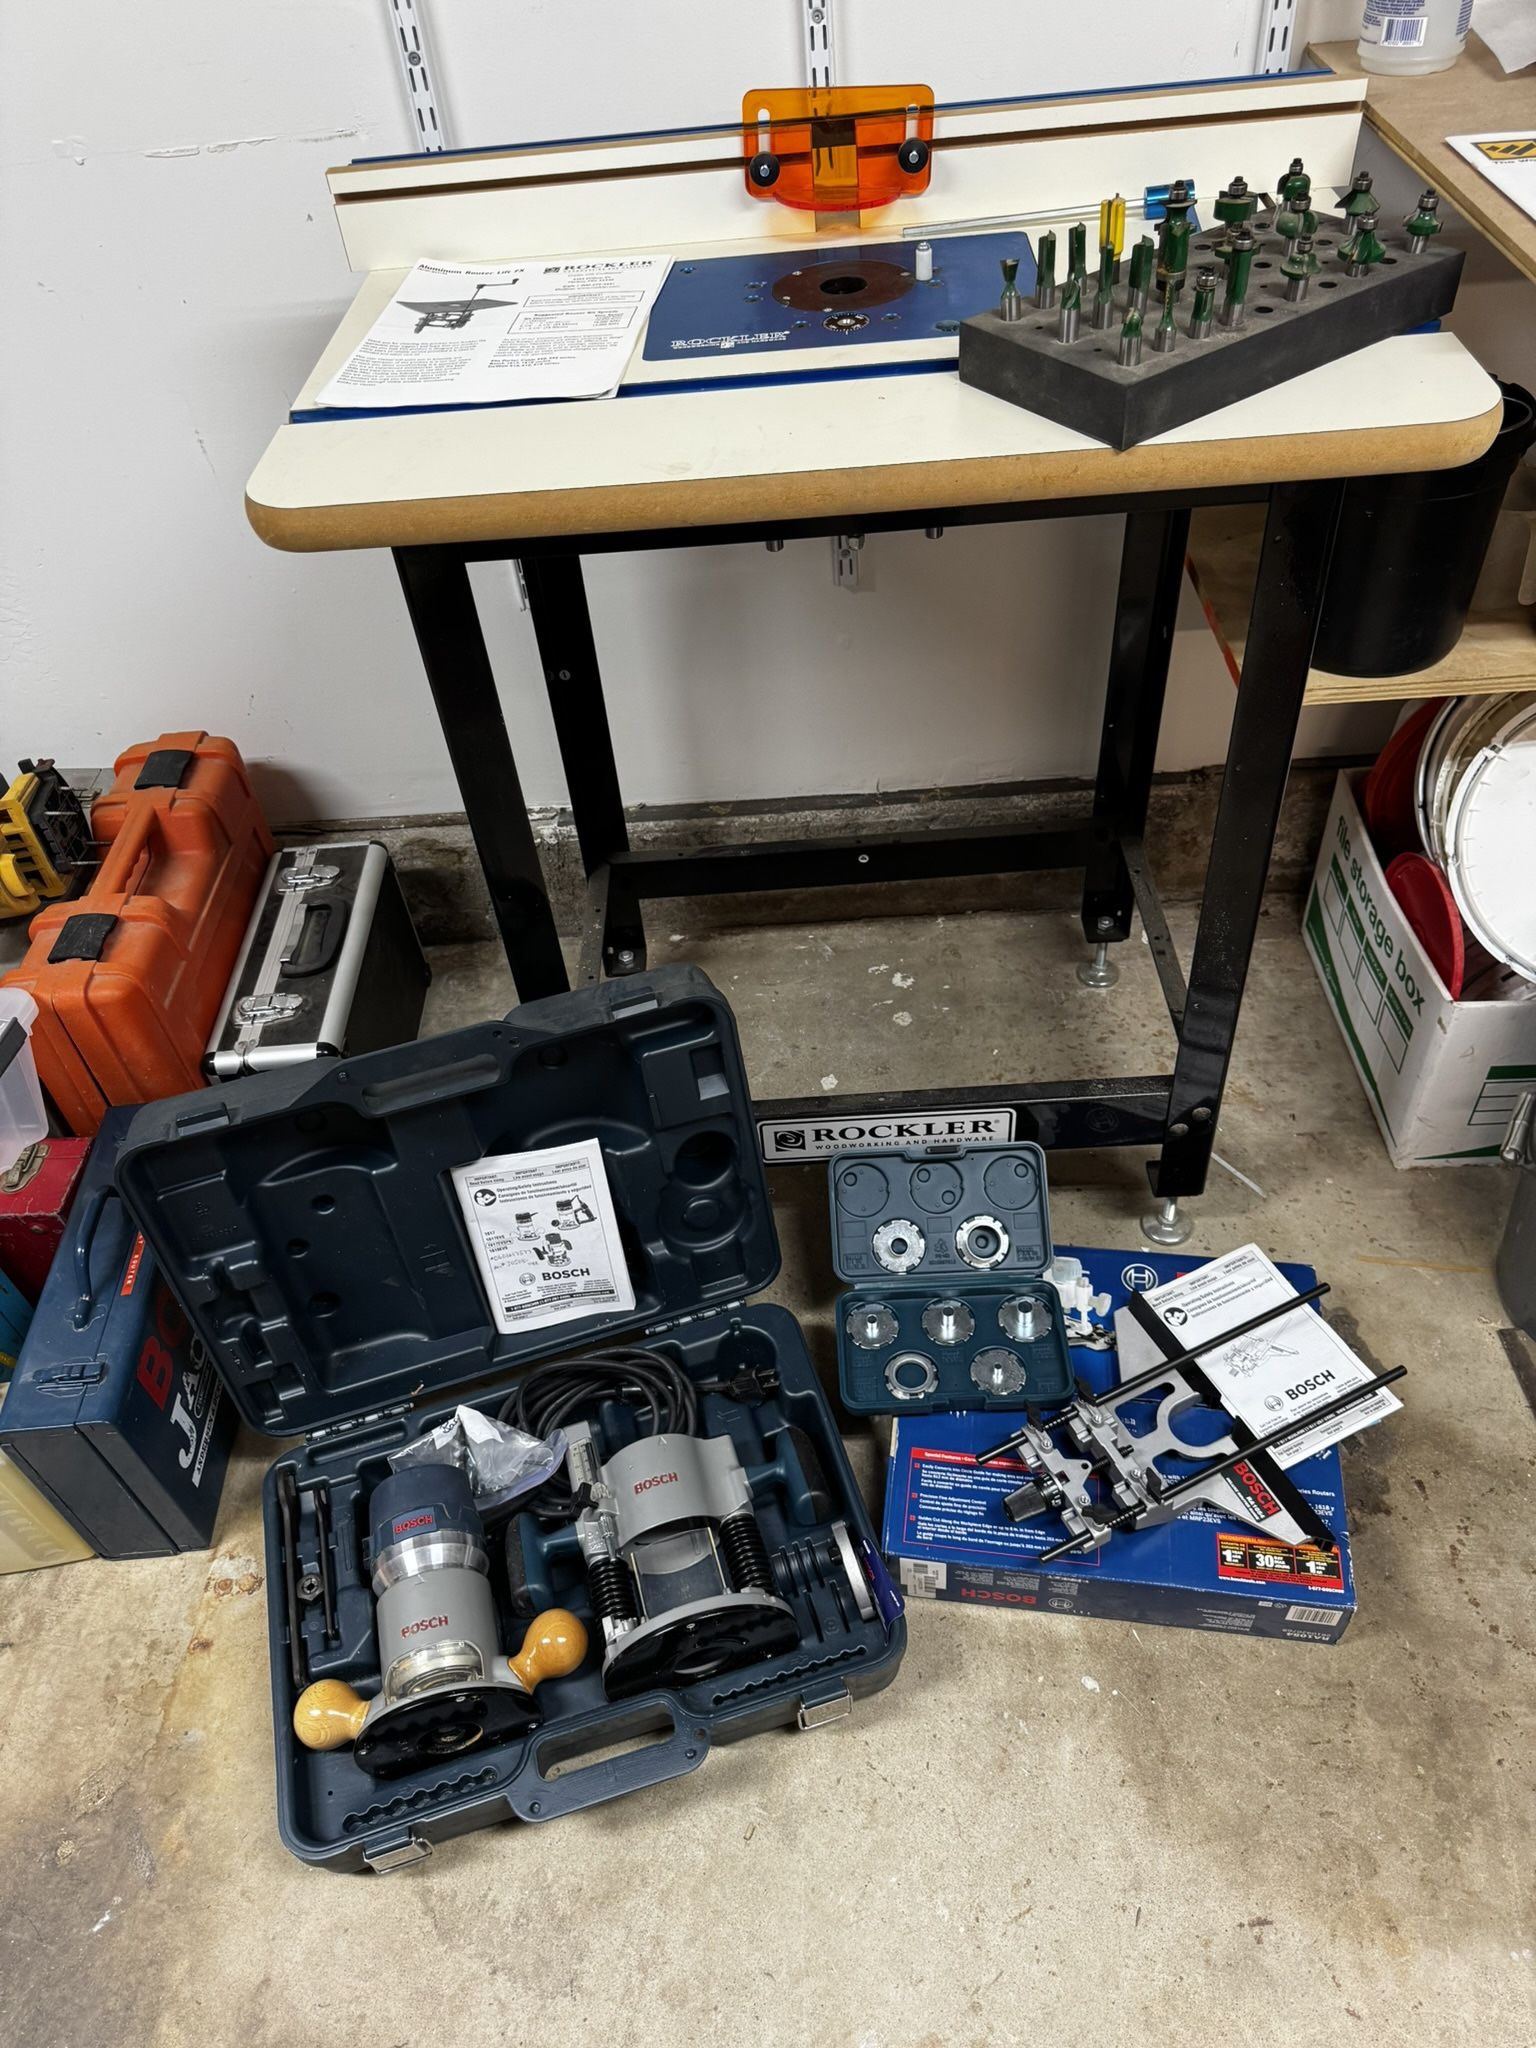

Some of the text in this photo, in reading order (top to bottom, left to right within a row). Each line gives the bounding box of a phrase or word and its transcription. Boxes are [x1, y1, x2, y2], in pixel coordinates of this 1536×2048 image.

[671, 332, 786, 347] ROCKLER
[1335, 814, 1351, 861] file
[1350, 857, 1394, 958] storage
[1395, 948, 1425, 1017] box
[811, 1120, 996, 1143] ROCKLER
[816, 1139, 900, 1150] WOODWORKING
[934, 1136, 994, 1144] HARDWARE
[542, 1267, 590, 1281] BOSCH
[1284, 1369, 1336, 1400] BOSCH
[634, 1472, 678, 1495] BOSCH
[1233, 1461, 1280, 1515] BOSCH
[1237, 1492, 1250, 1508] ROUTER
[1312, 1489, 1335, 1497] Routers
[1246, 1496, 1265, 1519] RA1054
[394, 1515, 433, 1534] BOSCH
[1222, 1549, 1232, 1562] 1
[1255, 1553, 1274, 1568] 30
[1305, 1561, 1315, 1574] 1
[1218, 1576, 1266, 1585] www.boschtools.com
[960, 1588, 1037, 1605] BOSCH
[401, 1615, 448, 1638] BOSCH
[1287, 1632, 1330, 1640] RA1054
